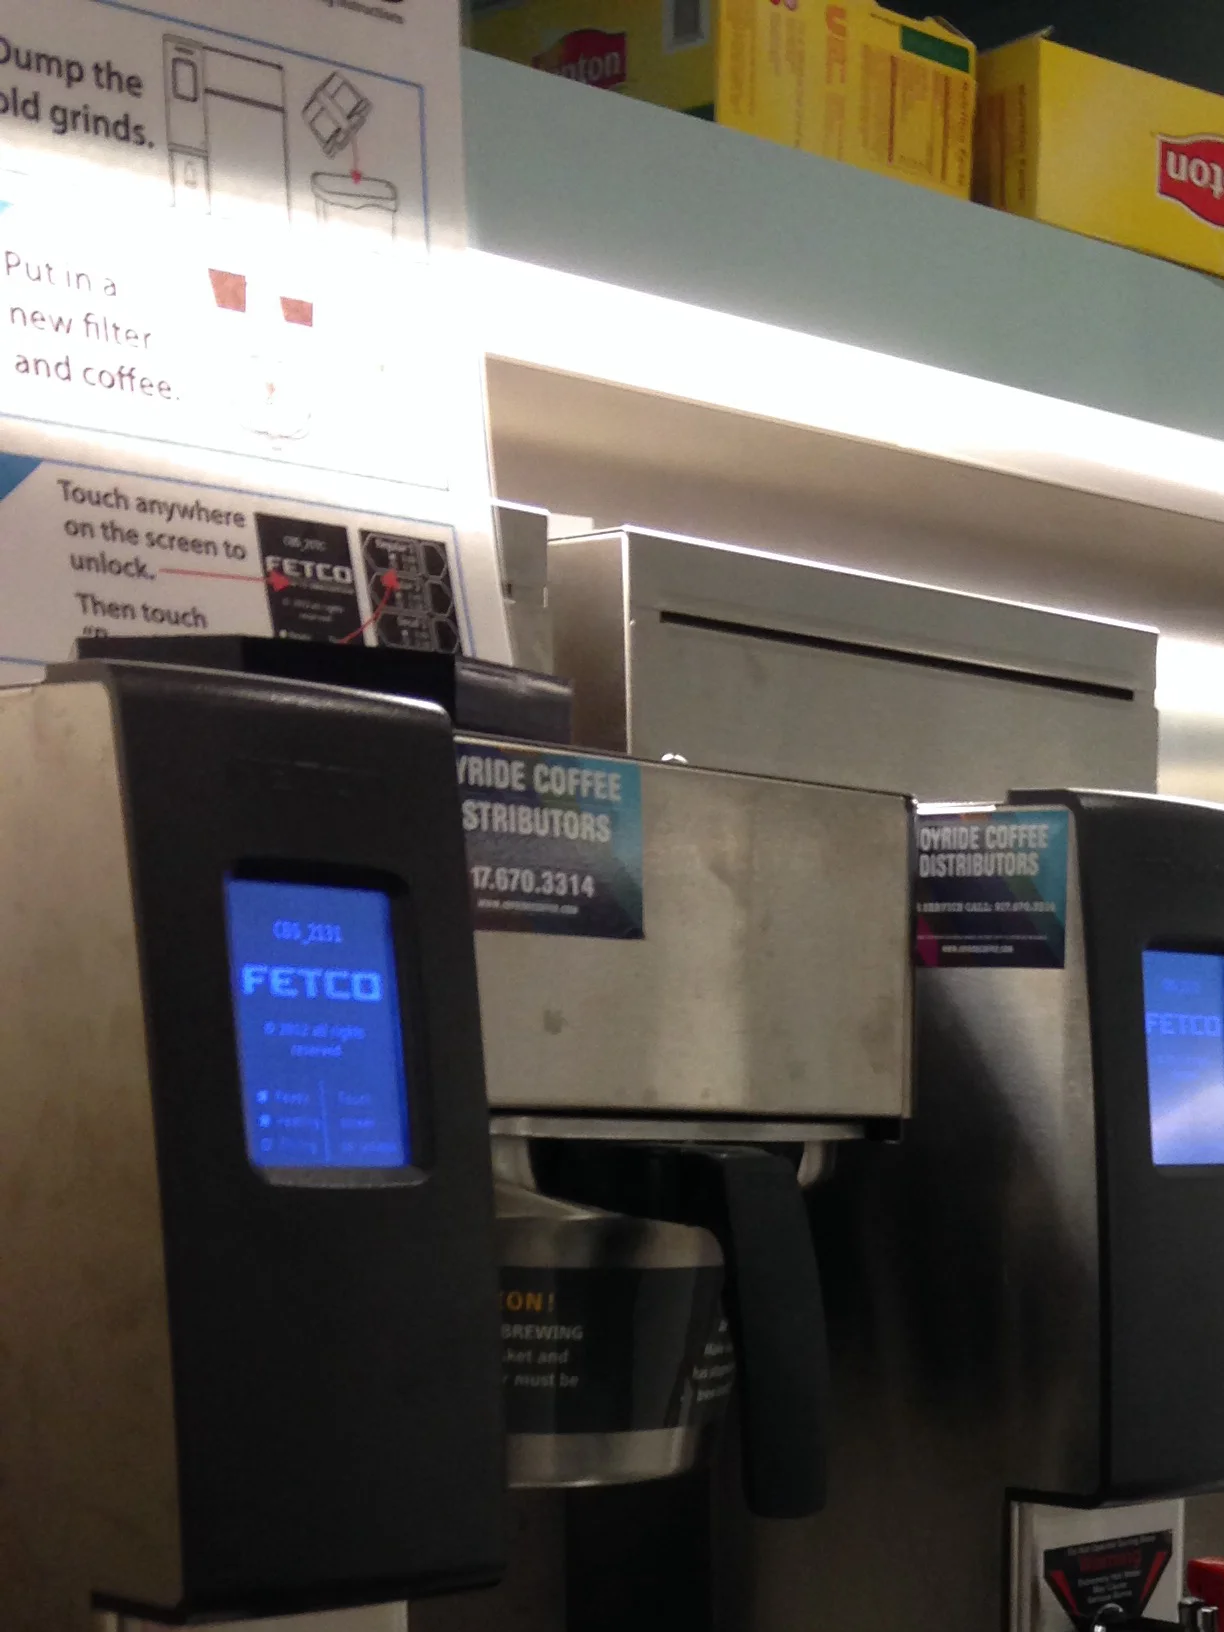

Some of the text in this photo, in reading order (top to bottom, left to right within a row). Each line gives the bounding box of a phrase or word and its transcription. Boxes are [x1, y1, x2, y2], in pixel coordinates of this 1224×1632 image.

[94, 60, 143, 97] the
[50, 103, 155, 149] grinds.
[5, 250, 117, 297] Put in a
[10, 306, 152, 349] new filter
[15, 354, 180, 401] and coffee.
[57, 478, 247, 529] Touch anywhere
[64, 518, 248, 561] on the screen to
[69, 550, 157, 581] unlock.
[265, 555, 353, 585] FETCO
[74, 591, 209, 630] Then touch
[532, 762, 623, 802] COFFEE
[461, 798, 613, 844] STRIBUTORS
[919, 824, 1050, 851] OYRIDE COFFEE
[470, 865, 596, 899] 17.670.3314
[919, 851, 1040, 878] DISTRIBUTORS
[240, 963, 384, 1003] FETCO
[1145, 1010, 1222, 1038] FETCO
[500, 1323, 584, 1341] BREWING
[537, 1347, 570, 1365] and
[514, 1372, 580, 1389] must be
